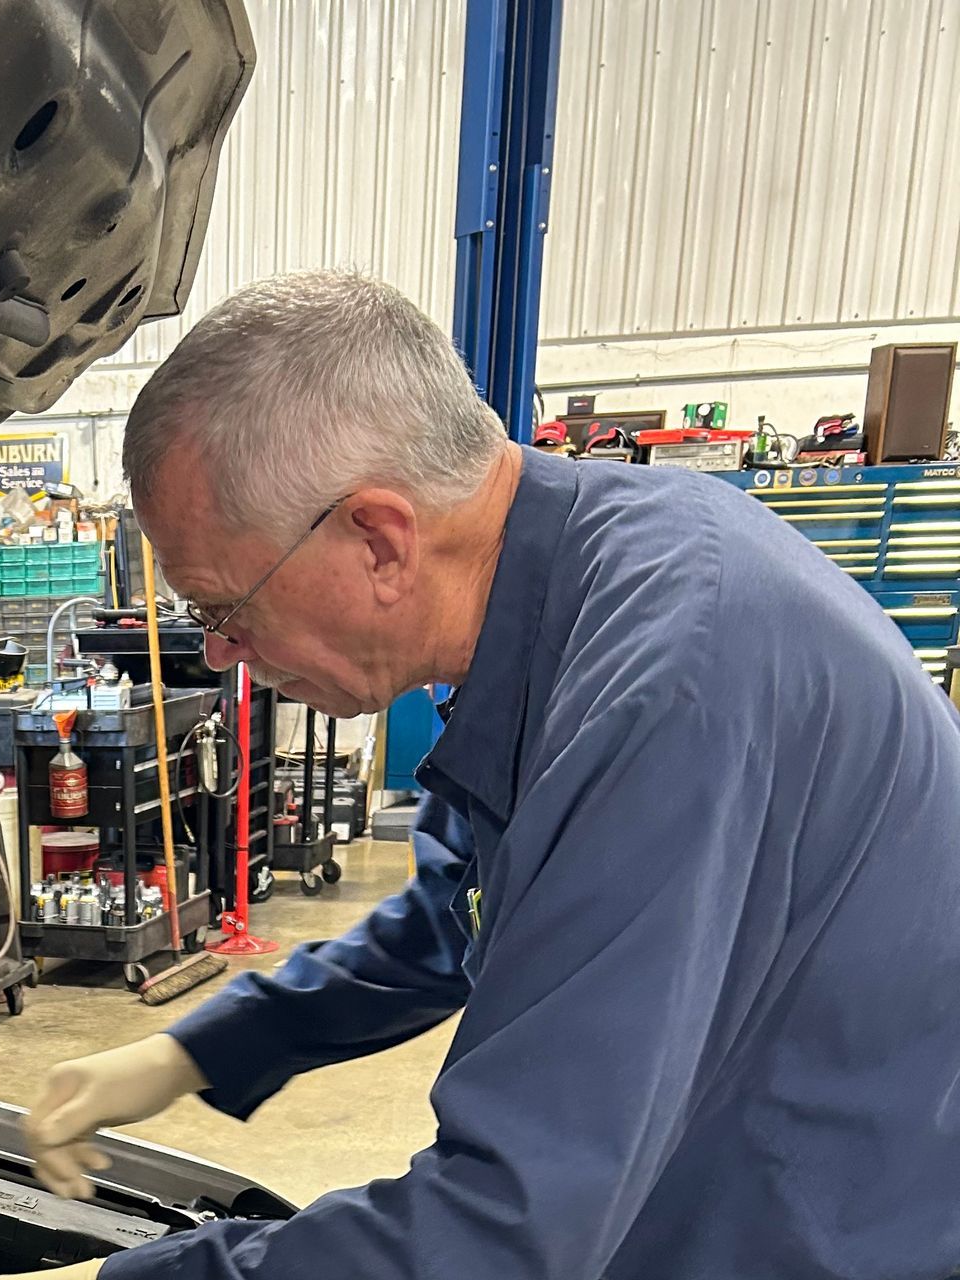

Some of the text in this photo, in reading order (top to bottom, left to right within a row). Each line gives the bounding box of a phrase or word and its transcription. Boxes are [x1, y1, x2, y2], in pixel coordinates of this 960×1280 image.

[0, 465, 30, 477] Sales
[924, 468, 955, 477] MATCO
[1, 477, 44, 489] Service
